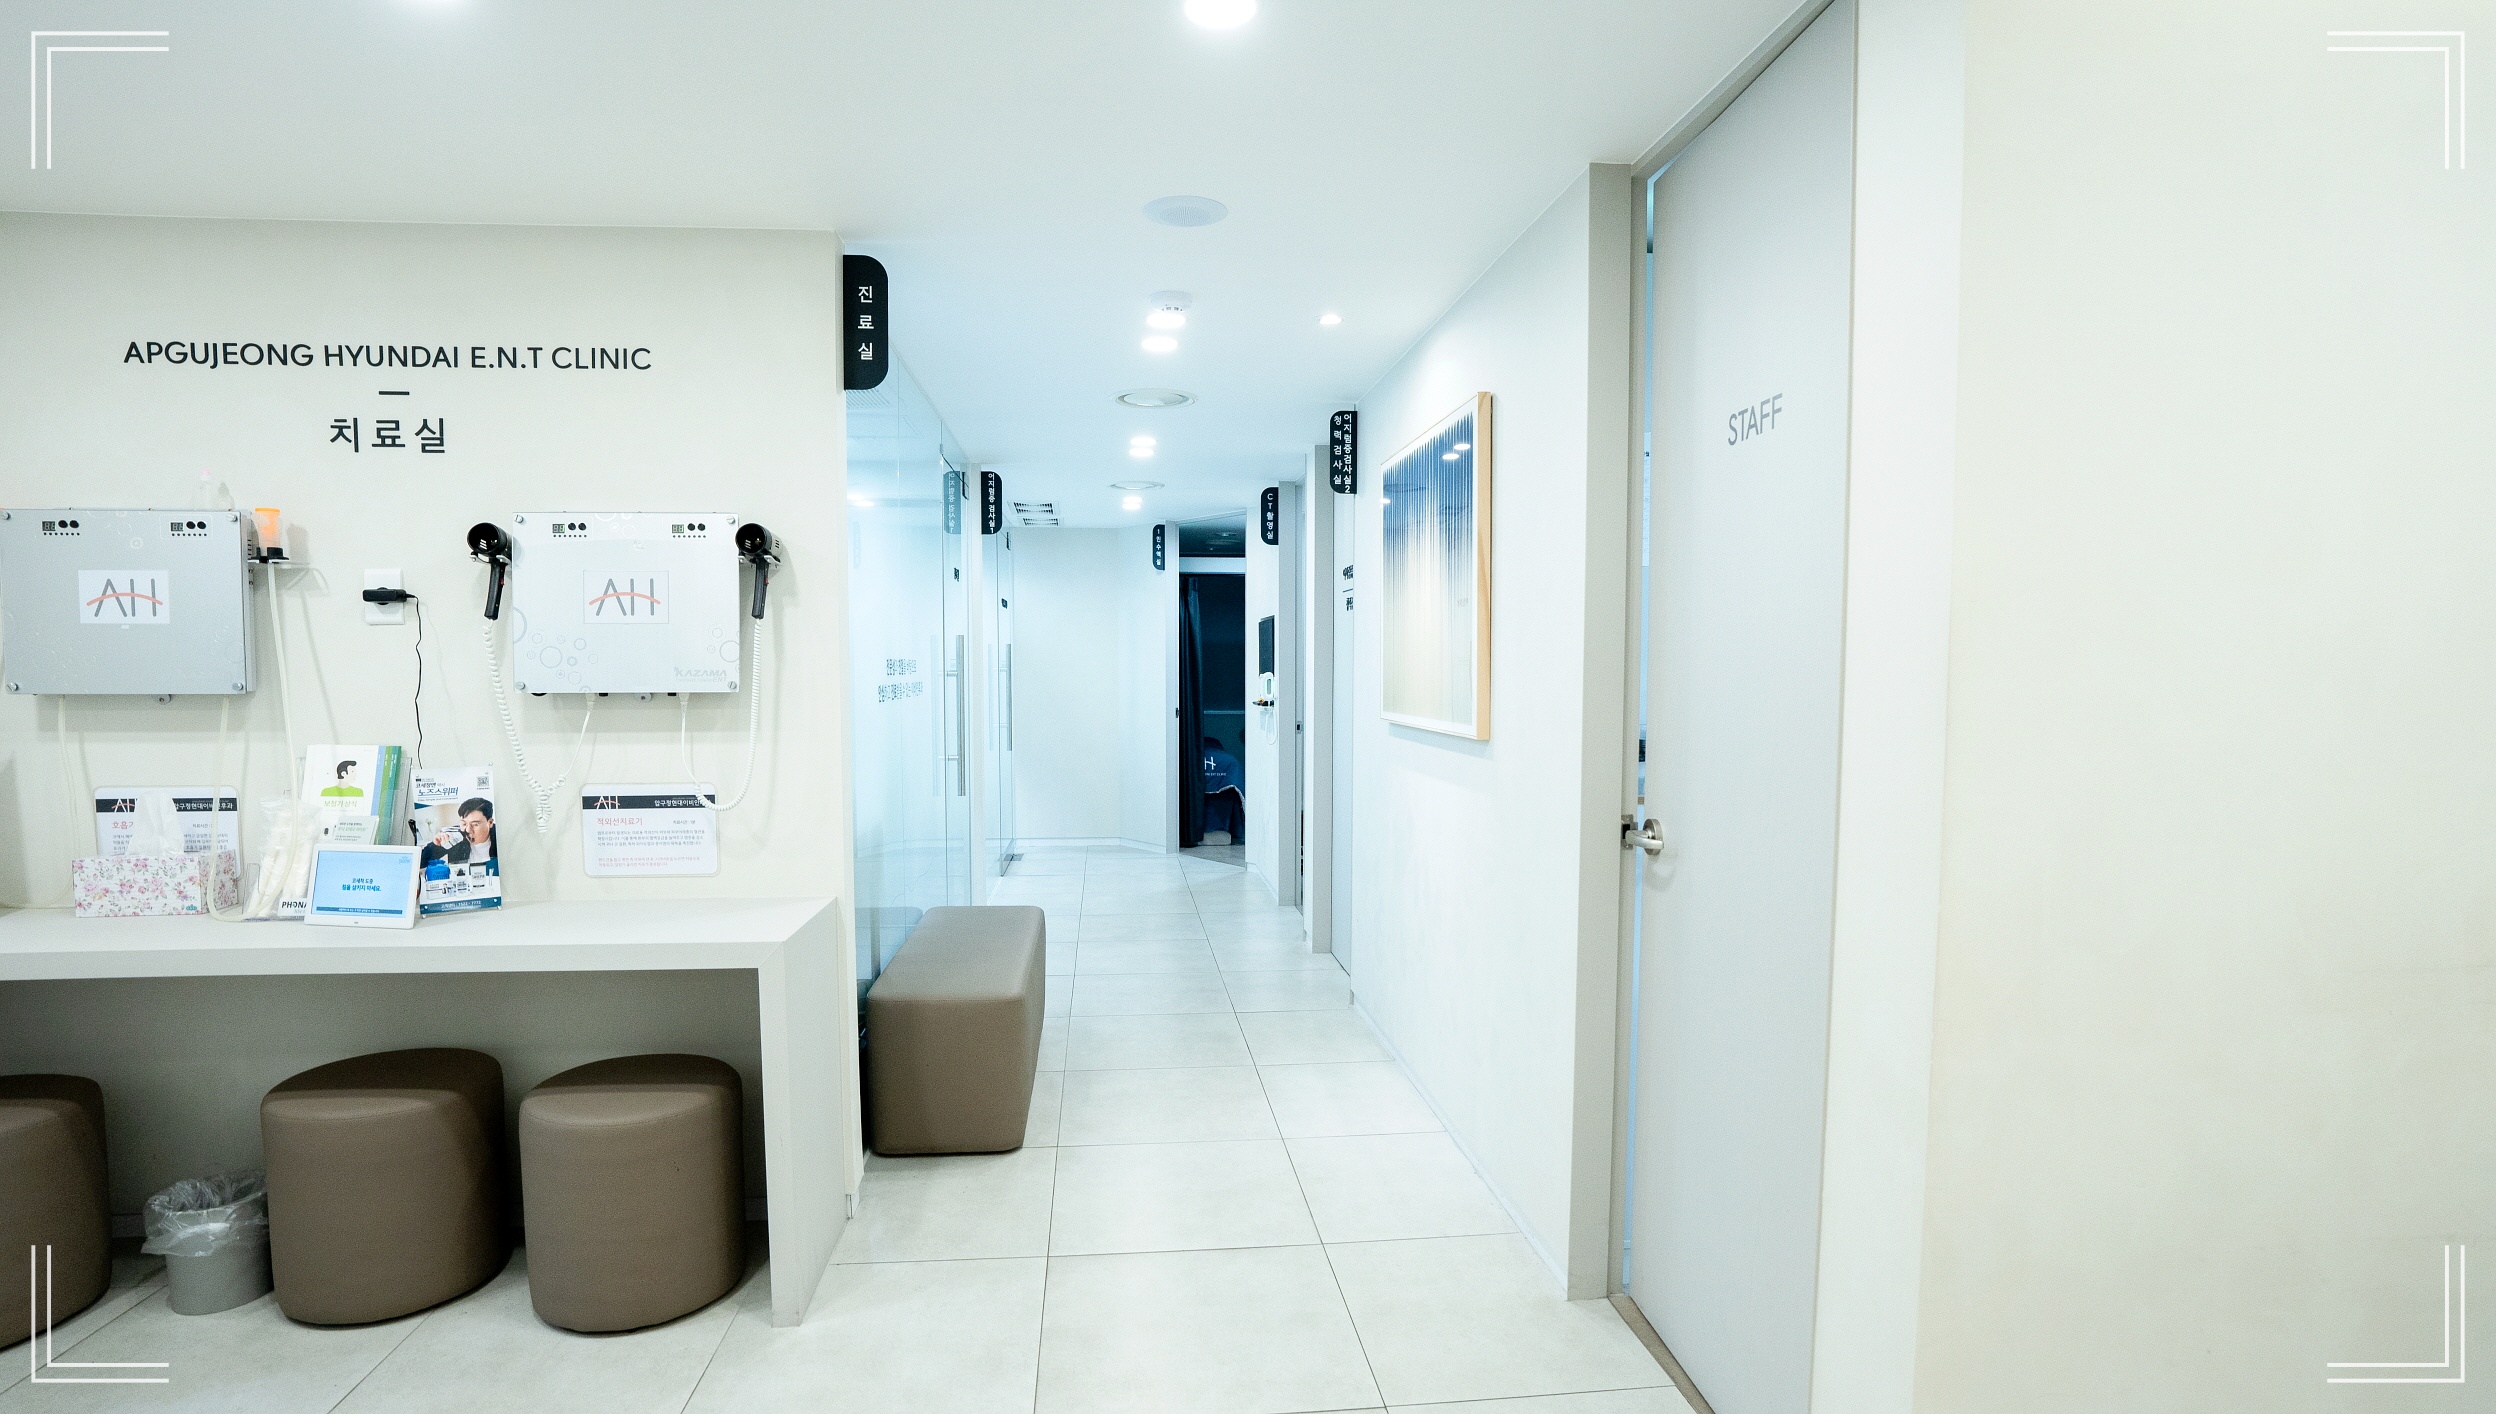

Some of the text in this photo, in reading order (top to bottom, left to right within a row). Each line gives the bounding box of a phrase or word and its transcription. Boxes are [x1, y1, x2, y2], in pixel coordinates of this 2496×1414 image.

[858, 285, 874, 360] 진료실
[123, 341, 652, 371] APGUJEONG HYUNDAI E.N.T CLINIC
[329, 417, 447, 454] 치료실
[1728, 393, 1782, 446] STAFF
[1333, 415, 1342, 485] 청력검사실
[87, 578, 163, 617] AH
[590, 578, 660, 616] AH
[675, 669, 727, 677] KAZAMA
[597, 817, 643, 826] 적외선치료기
[654, 799, 702, 808] 압구정현대이비인
